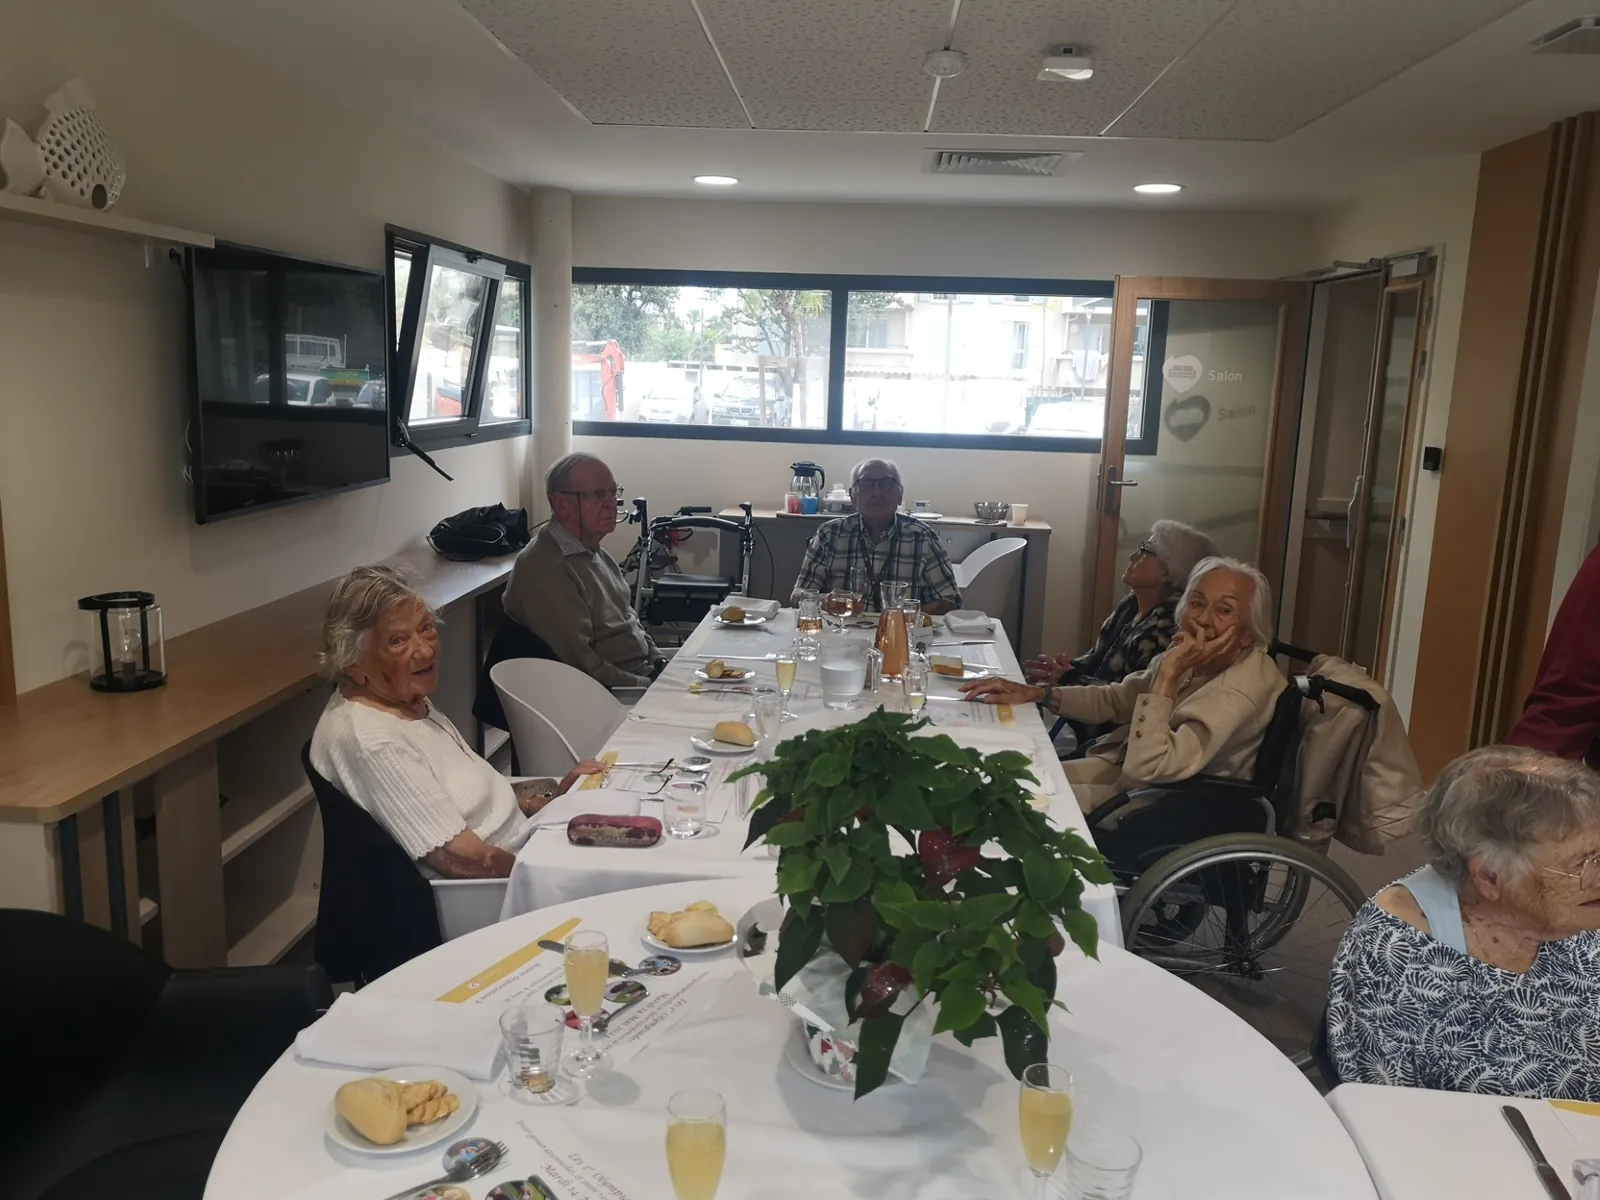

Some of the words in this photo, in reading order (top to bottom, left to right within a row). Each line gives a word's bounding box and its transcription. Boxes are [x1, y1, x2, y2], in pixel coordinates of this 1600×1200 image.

[1207, 370, 1243, 382] Salon
[568, 1153, 585, 1165] Les
[541, 1164, 572, 1188] Mardi
